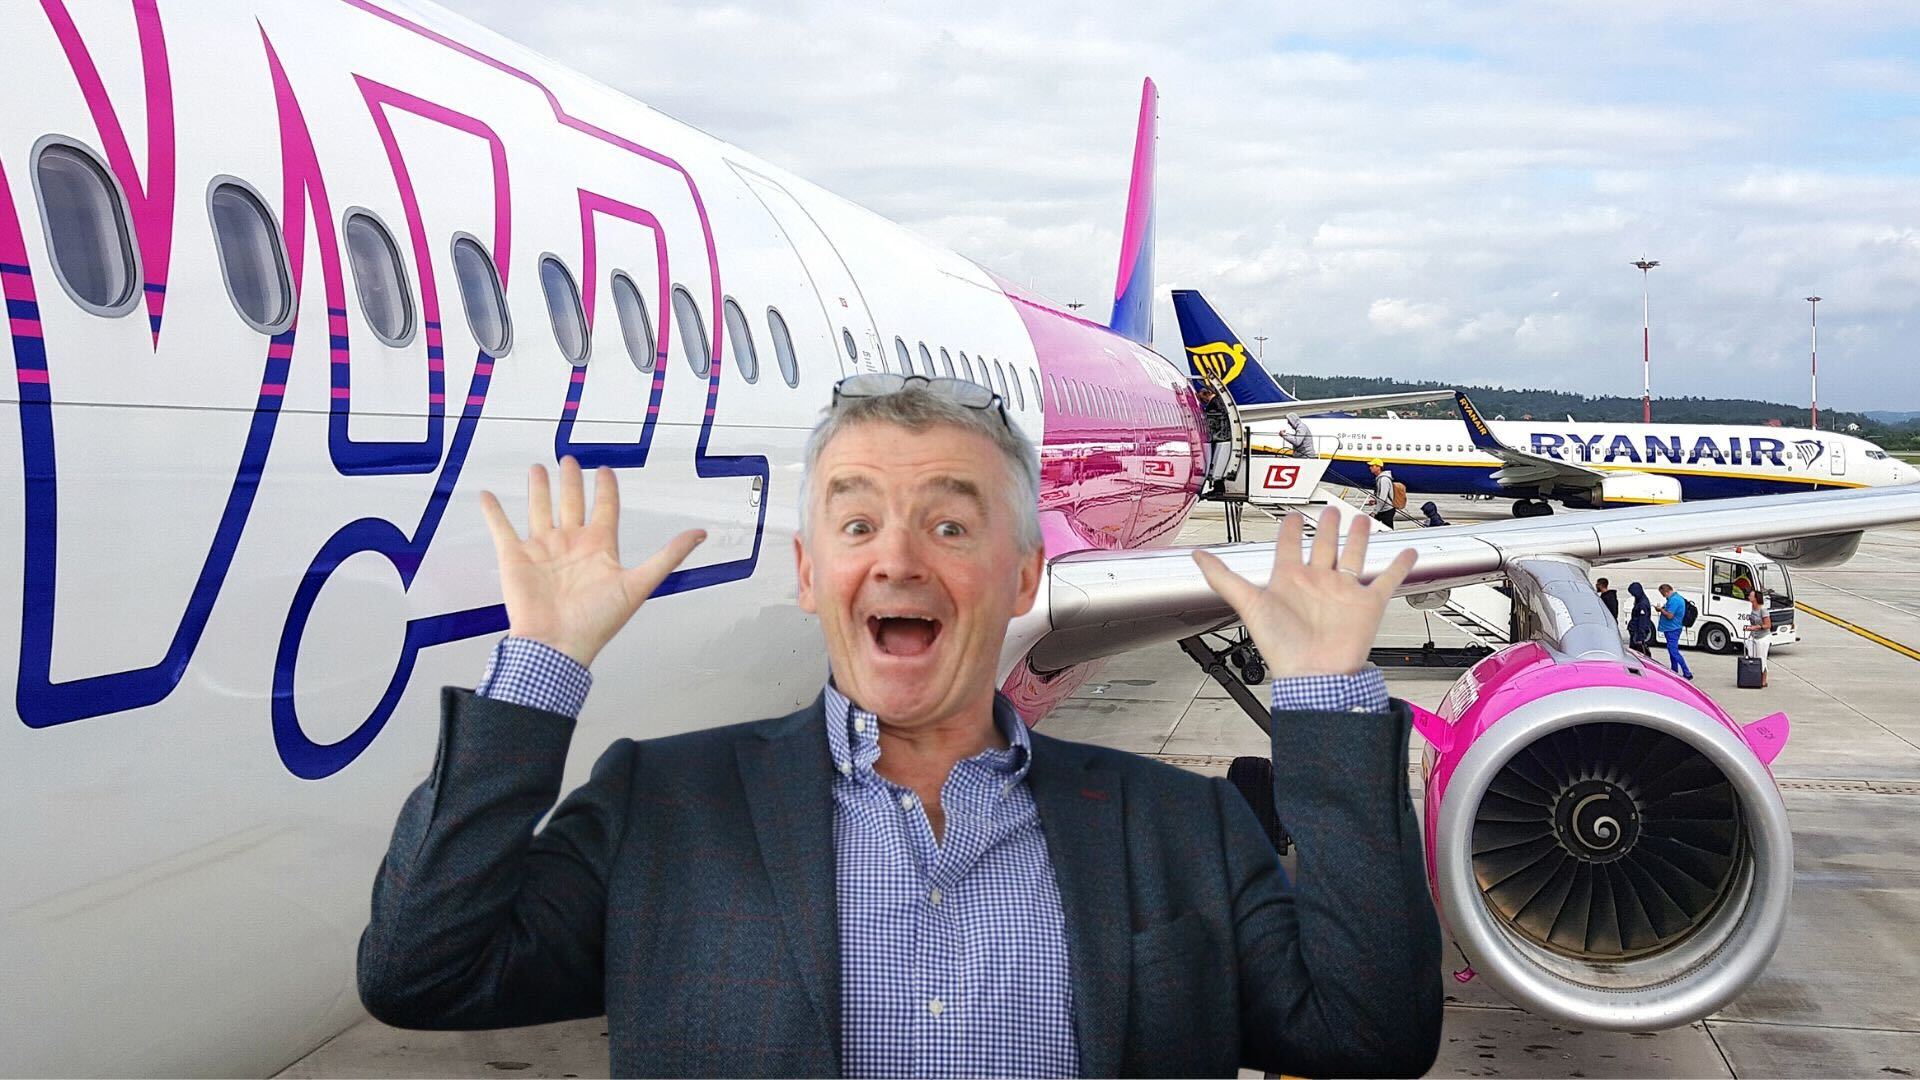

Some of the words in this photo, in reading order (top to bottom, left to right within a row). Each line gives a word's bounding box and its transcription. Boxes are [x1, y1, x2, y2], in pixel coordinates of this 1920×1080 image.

[1459, 398, 1487, 436] RYANAIR
[1530, 433, 1786, 466] RYANAIR
[1266, 467, 1297, 487] LS
